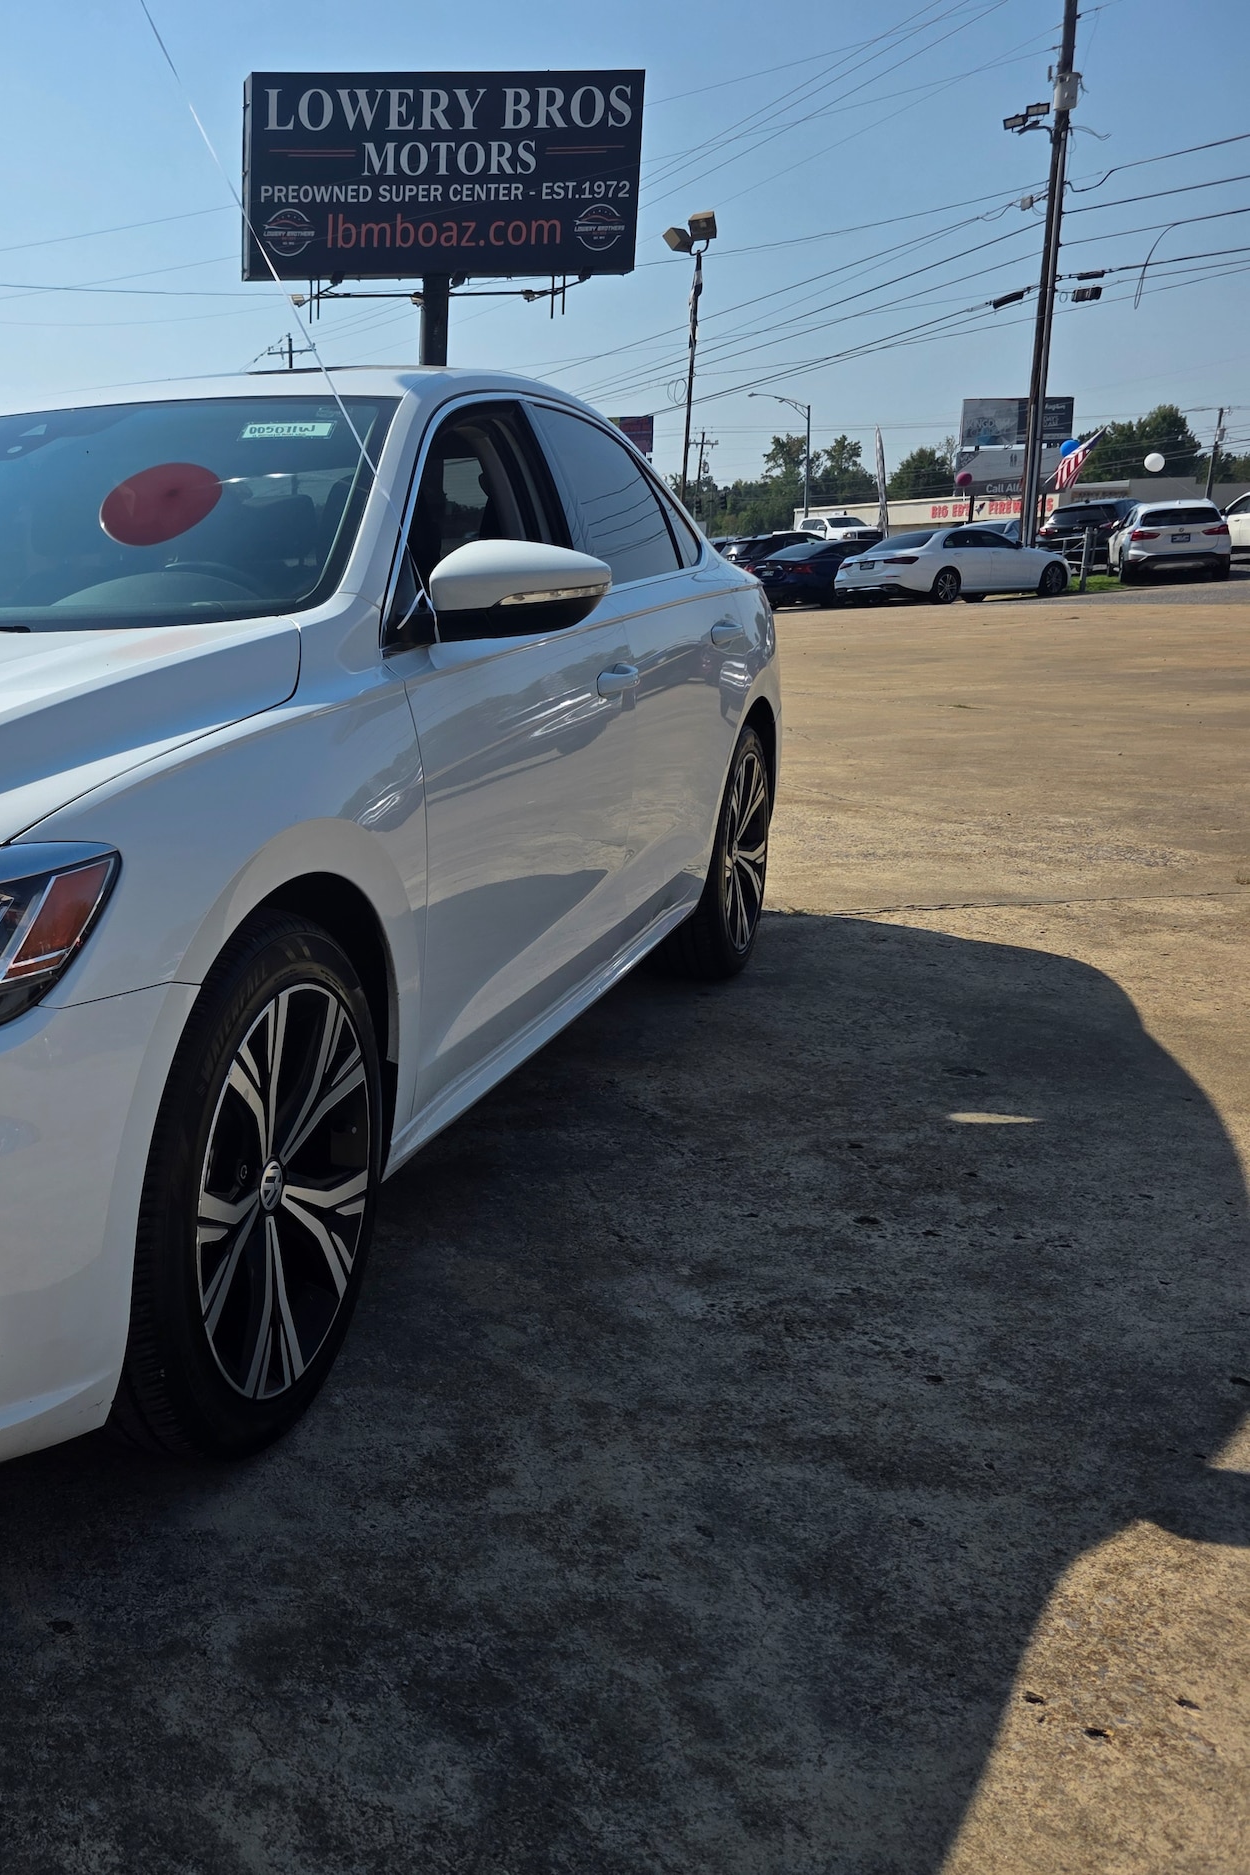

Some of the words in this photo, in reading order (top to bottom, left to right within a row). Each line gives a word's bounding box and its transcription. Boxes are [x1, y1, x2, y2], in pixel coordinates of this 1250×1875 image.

[264, 88, 488, 131] LOWERY
[500, 85, 632, 130] BROS
[361, 140, 536, 176] MOTORS
[260, 185, 373, 203] PREOWNED
[378, 184, 443, 203] SUPER
[449, 183, 524, 202] CENTER
[542, 180, 630, 200] EST.1972
[327, 213, 561, 248] lbmboaz.com
[986, 483, 1004, 493] Call
[931, 505, 949, 518] BIG
[988, 498, 1054, 515] FIREWS
